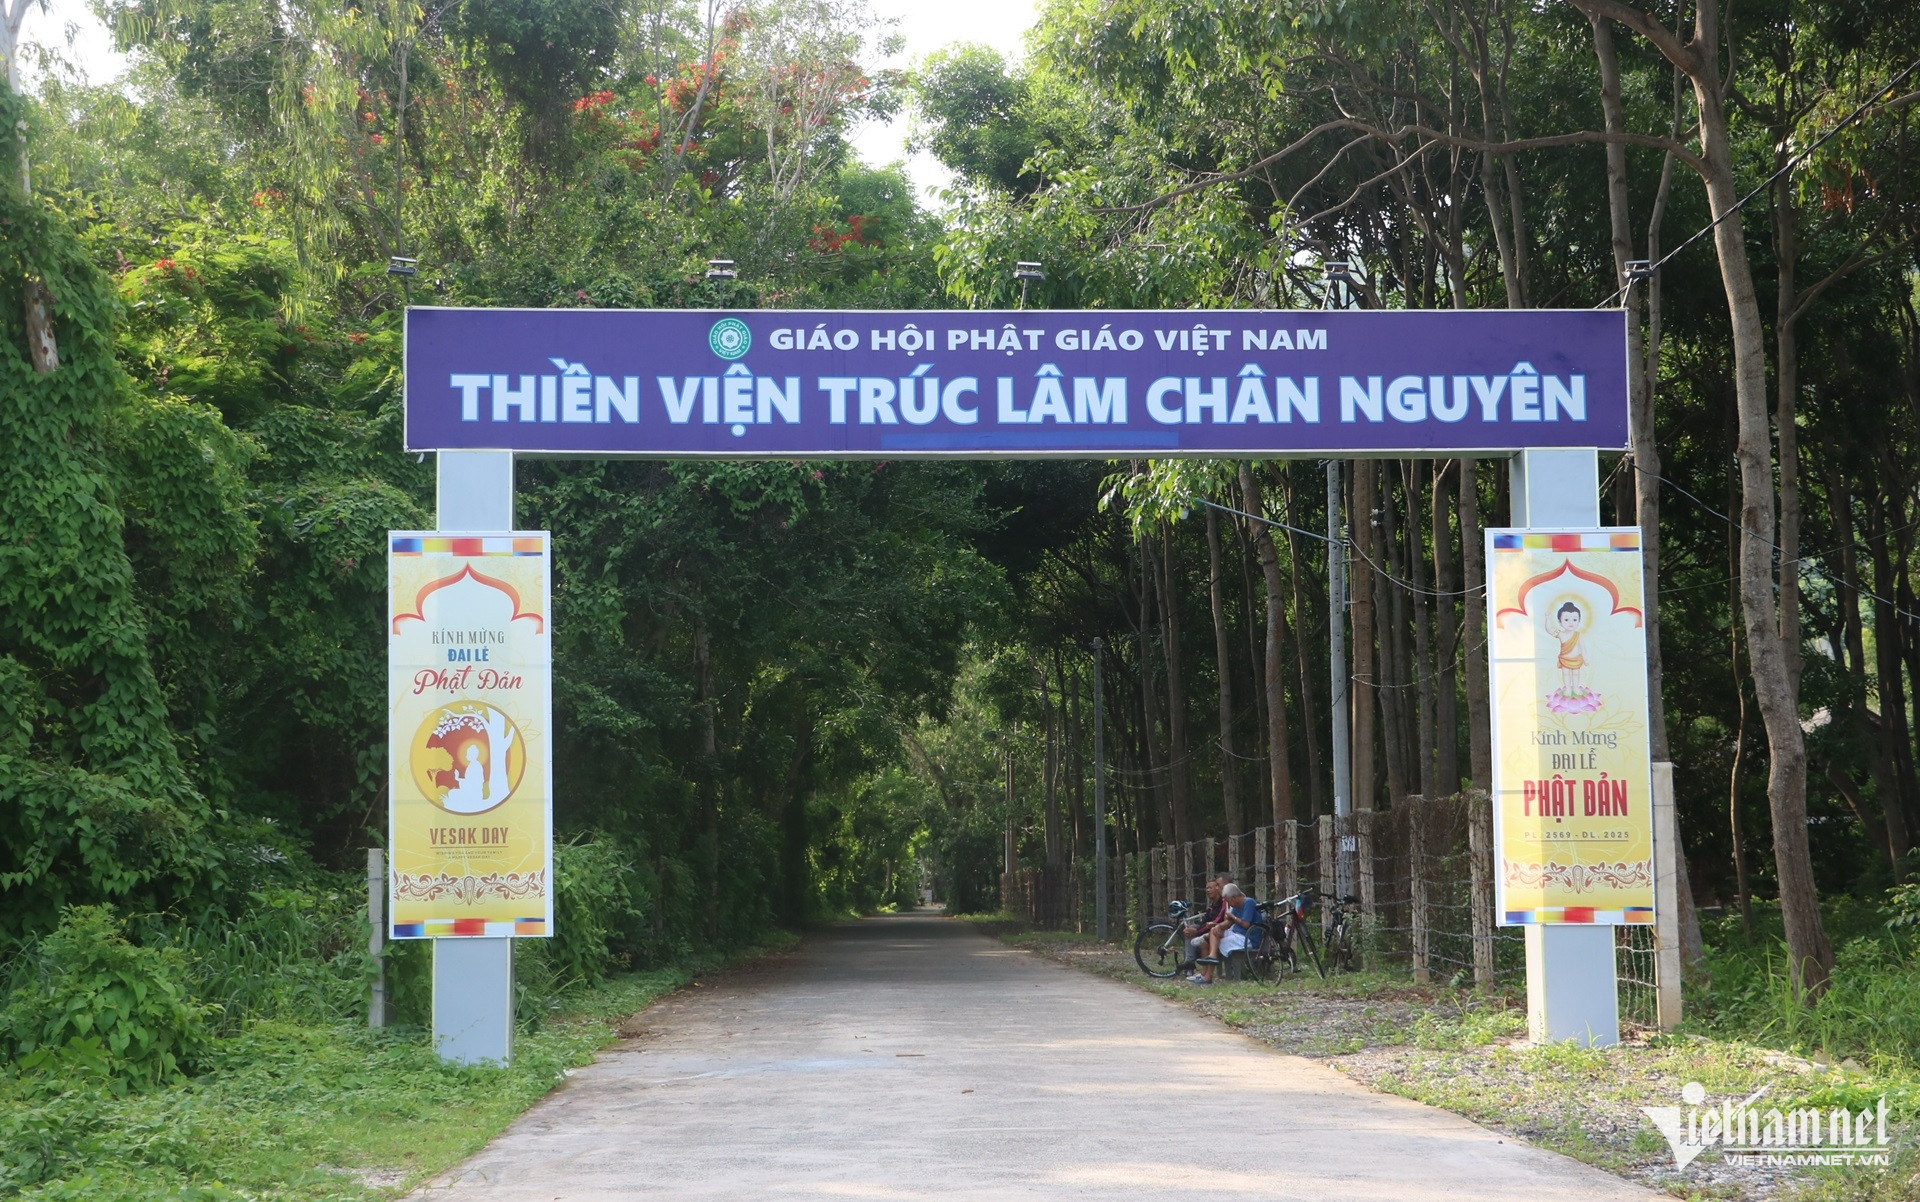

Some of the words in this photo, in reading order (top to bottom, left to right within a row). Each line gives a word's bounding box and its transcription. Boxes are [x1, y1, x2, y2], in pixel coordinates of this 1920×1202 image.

[769, 323, 860, 351] GIÁO
[870, 323, 935, 357] HỘI
[947, 323, 1046, 357] PHẬT
[1054, 323, 1144, 351] GIÁO
[1153, 323, 1232, 357] VIỆT
[1242, 329, 1328, 351] NAM
[449, 357, 640, 424] THIỀN
[655, 361, 802, 438] VIỆN
[817, 362, 979, 426] TRÚC
[996, 362, 1129, 425] LÂM
[1145, 362, 1321, 425] CHÂN
[1338, 361, 1587, 424] NGUYÊN
[432, 628, 464, 644] KÍNH
[468, 627, 505, 644] MỪNG
[413, 665, 476, 695] Phật
[477, 668, 523, 690] Đản
[1531, 730, 1567, 745] Kính
[1572, 730, 1617, 749] Mừng
[1552, 753, 1576, 773] ĐẠI
[1580, 747, 1597, 770] LỄ
[1523, 774, 1577, 823] PHẬT
[1583, 772, 1628, 817] ĐẢN
[429, 827, 477, 845] VESAK
[482, 827, 509, 844] DAY
[1546, 831, 1571, 839] 2569
[1603, 831, 1630, 839] 2025
